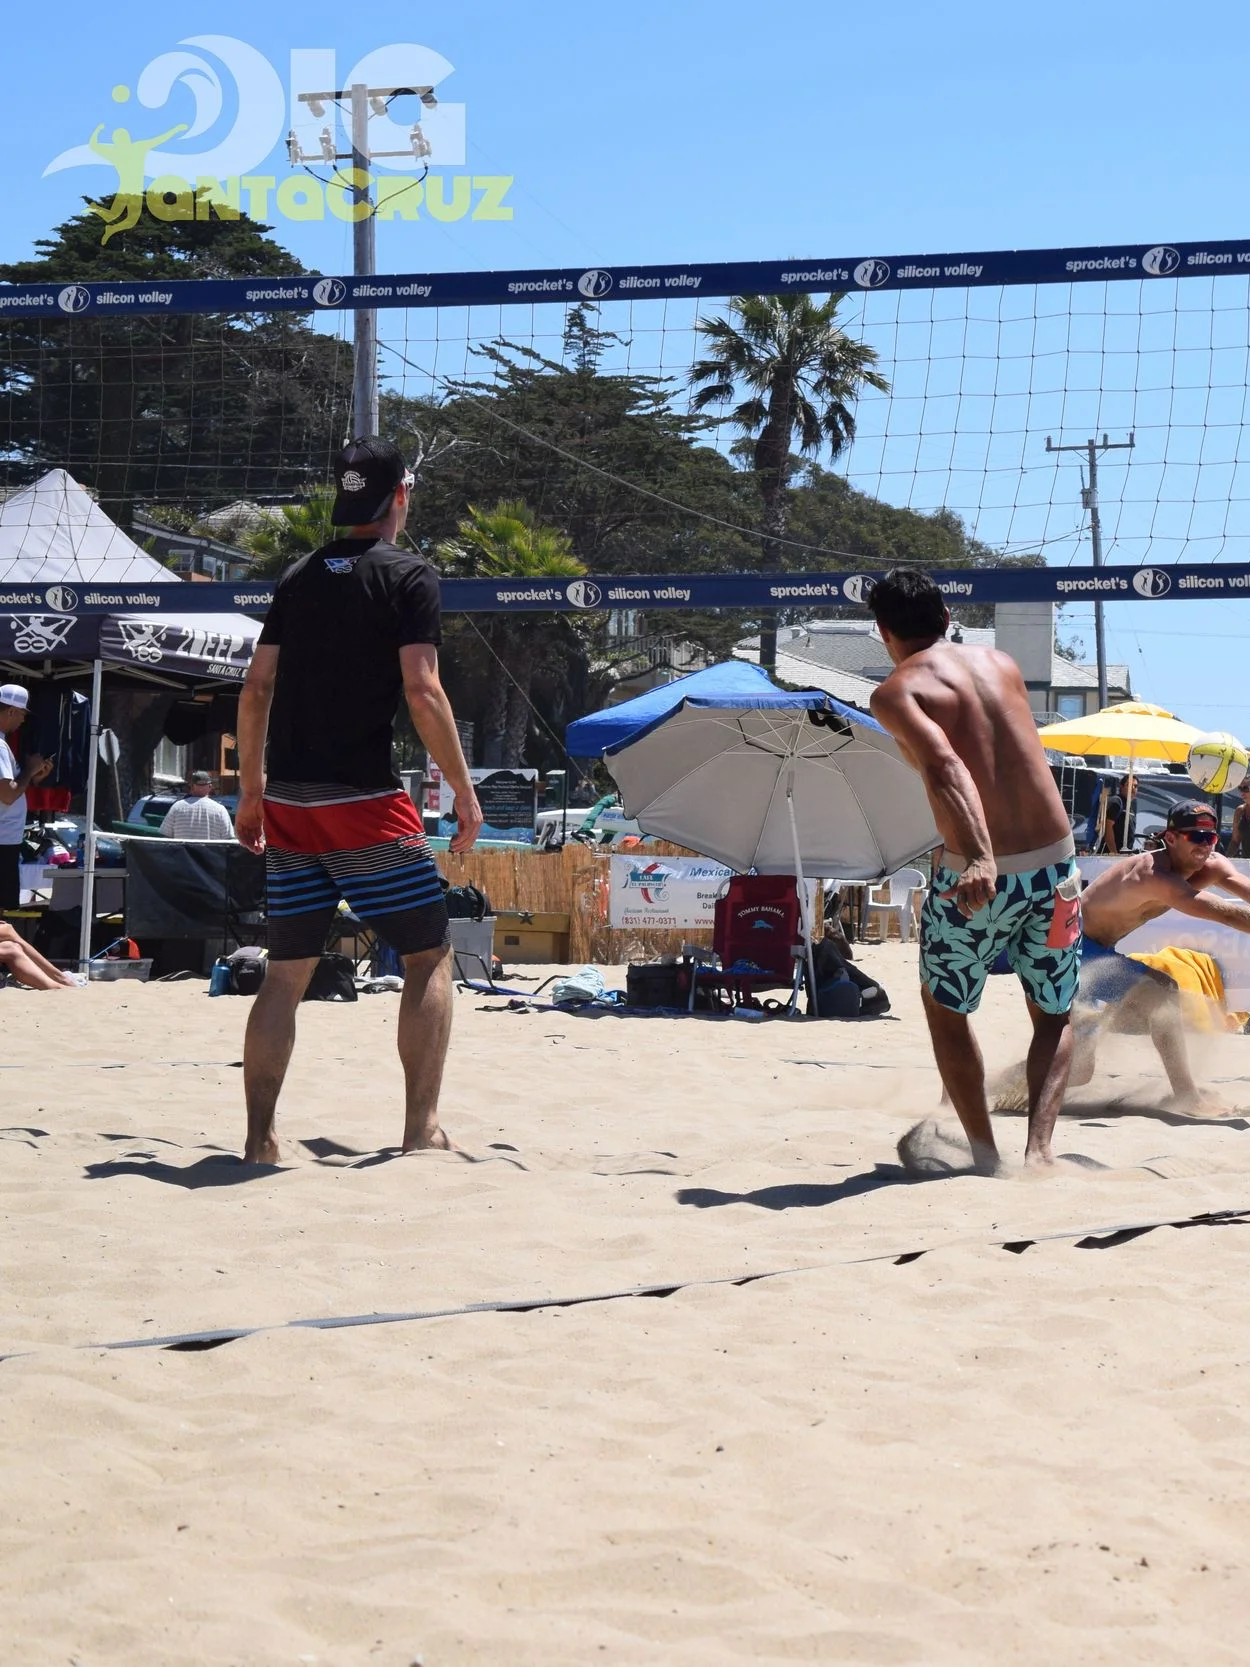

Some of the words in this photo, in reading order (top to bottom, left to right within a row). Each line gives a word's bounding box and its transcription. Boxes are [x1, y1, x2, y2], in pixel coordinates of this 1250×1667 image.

[1066, 256, 1137, 272] sprocket's
[1187, 250, 1233, 266] silicon
[780, 268, 848, 284] sprocket's
[897, 264, 940, 279] silicon
[944, 263, 983, 280] volley
[507, 279, 574, 294] sprocket's
[619, 276, 661, 289] silicon
[664, 274, 702, 290] volley
[0, 294, 54, 308] procket's
[96, 292, 134, 304] silicon
[138, 292, 172, 306] volley
[246, 287, 309, 302] sprocket's
[352, 284, 392, 298] silicon
[396, 284, 432, 298] volley
[770, 583, 839, 599] sprocket's
[1056, 576, 1128, 593] sprocket's
[1178, 574, 1225, 589] silicon
[0, 592, 42, 605] ocket's
[84, 592, 122, 605] silicon
[126, 592, 160, 607] volley
[233, 592, 275, 606] sprock
[496, 588, 562, 603] sprocket's
[608, 586, 650, 600] silicon
[653, 586, 691, 602] volley
[176, 626, 245, 663] 2DEEP
[206, 663, 226, 675] SANTA
[225, 665, 242, 677] CRUZ
[738, 906, 760, 918] TOMMY
[760, 906, 785, 918] BAHAMA
